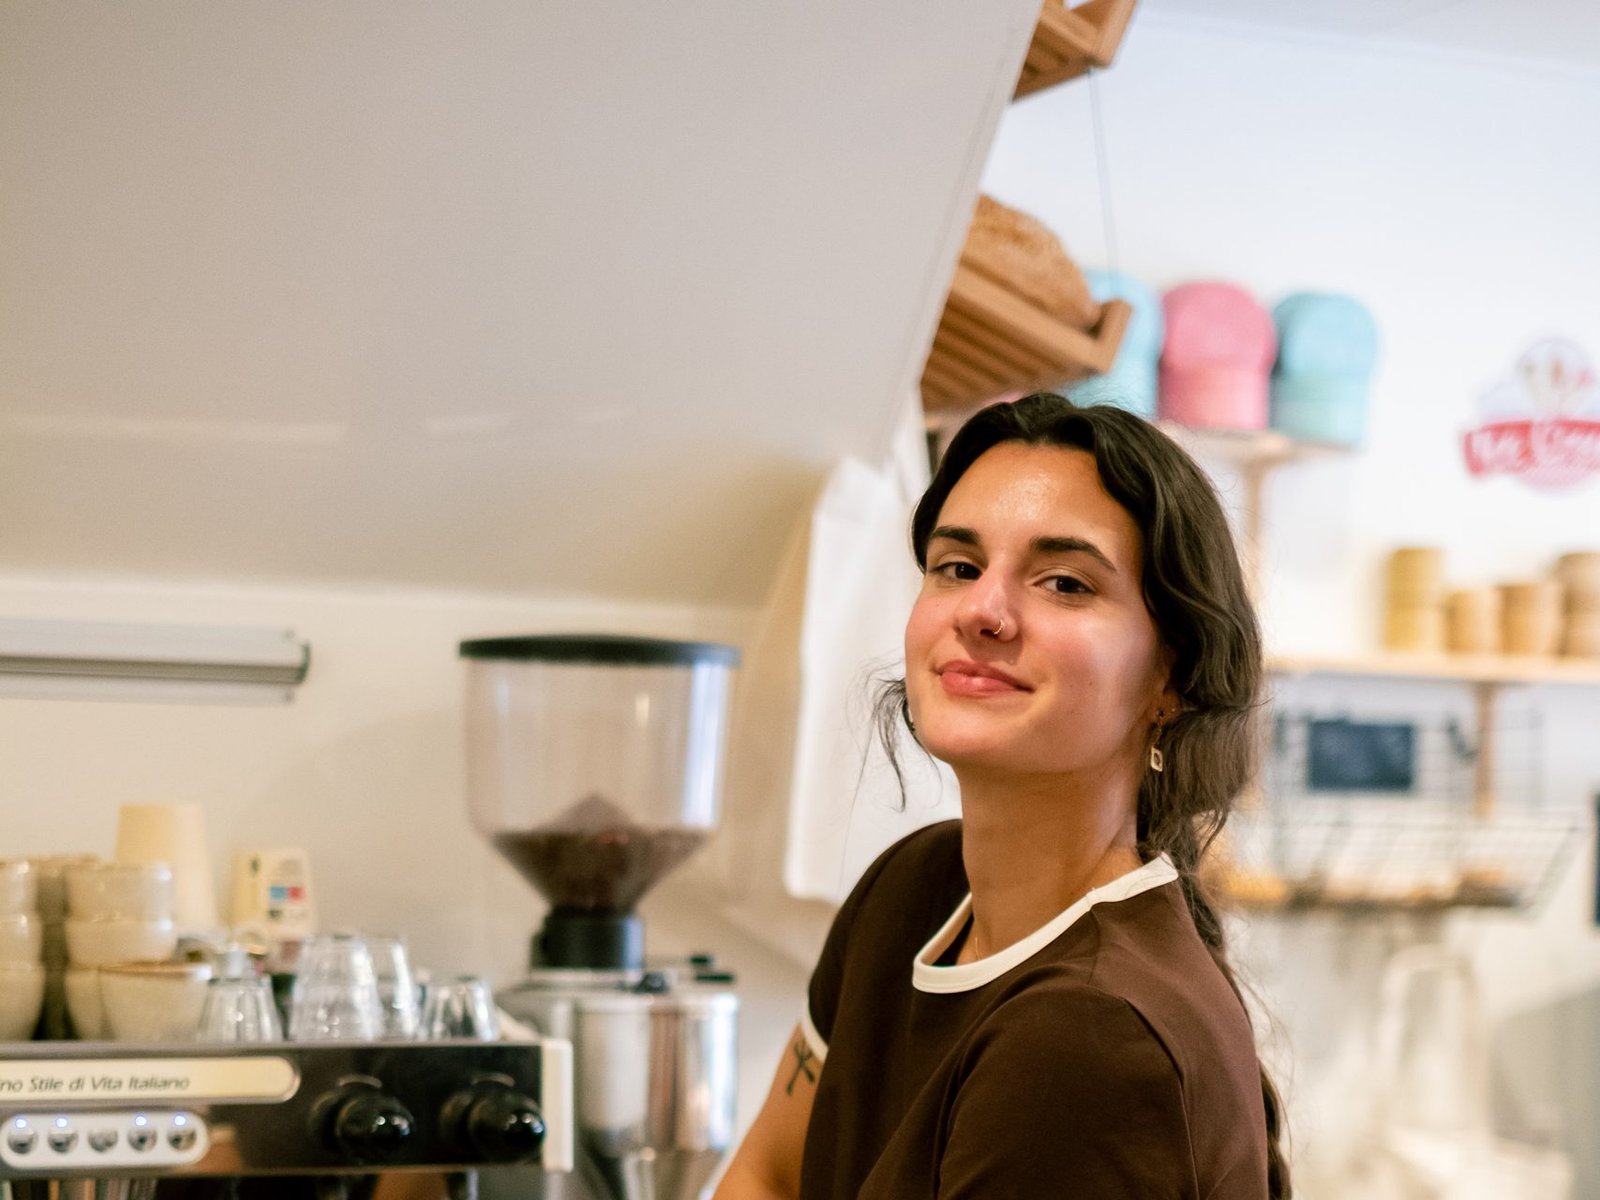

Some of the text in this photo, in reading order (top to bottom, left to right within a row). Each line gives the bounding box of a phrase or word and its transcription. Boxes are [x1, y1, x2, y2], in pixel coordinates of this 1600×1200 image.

[0, 1074, 191, 1092] no Stile di Vita Italiano
